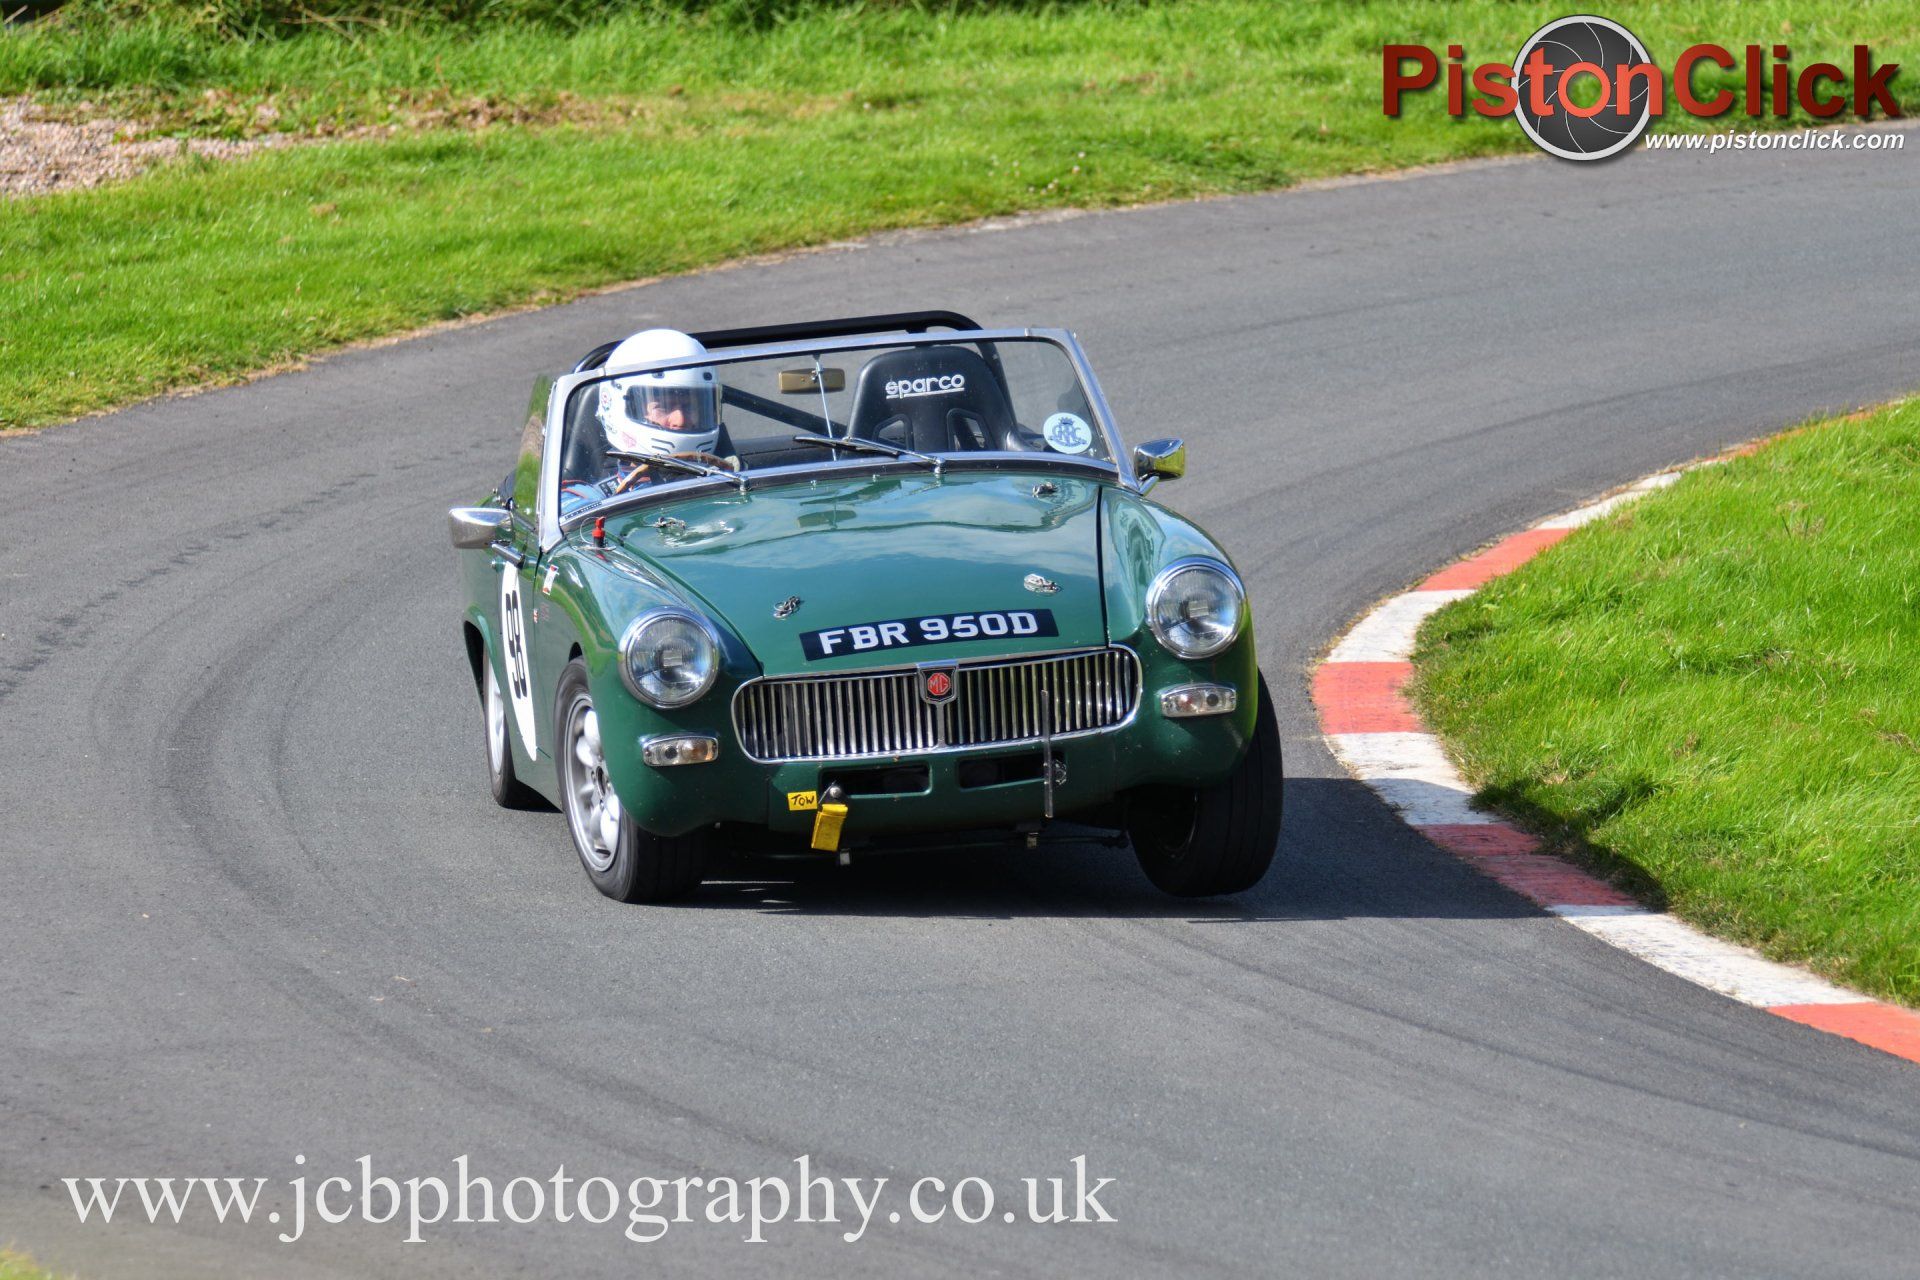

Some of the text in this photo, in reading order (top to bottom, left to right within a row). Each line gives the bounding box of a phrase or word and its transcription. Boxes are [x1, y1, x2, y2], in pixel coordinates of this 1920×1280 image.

[885, 374, 965, 399] sparco
[818, 612, 1039, 654] FBR 950D
[928, 674, 949, 693] MG
[791, 794, 815, 806] TOW
